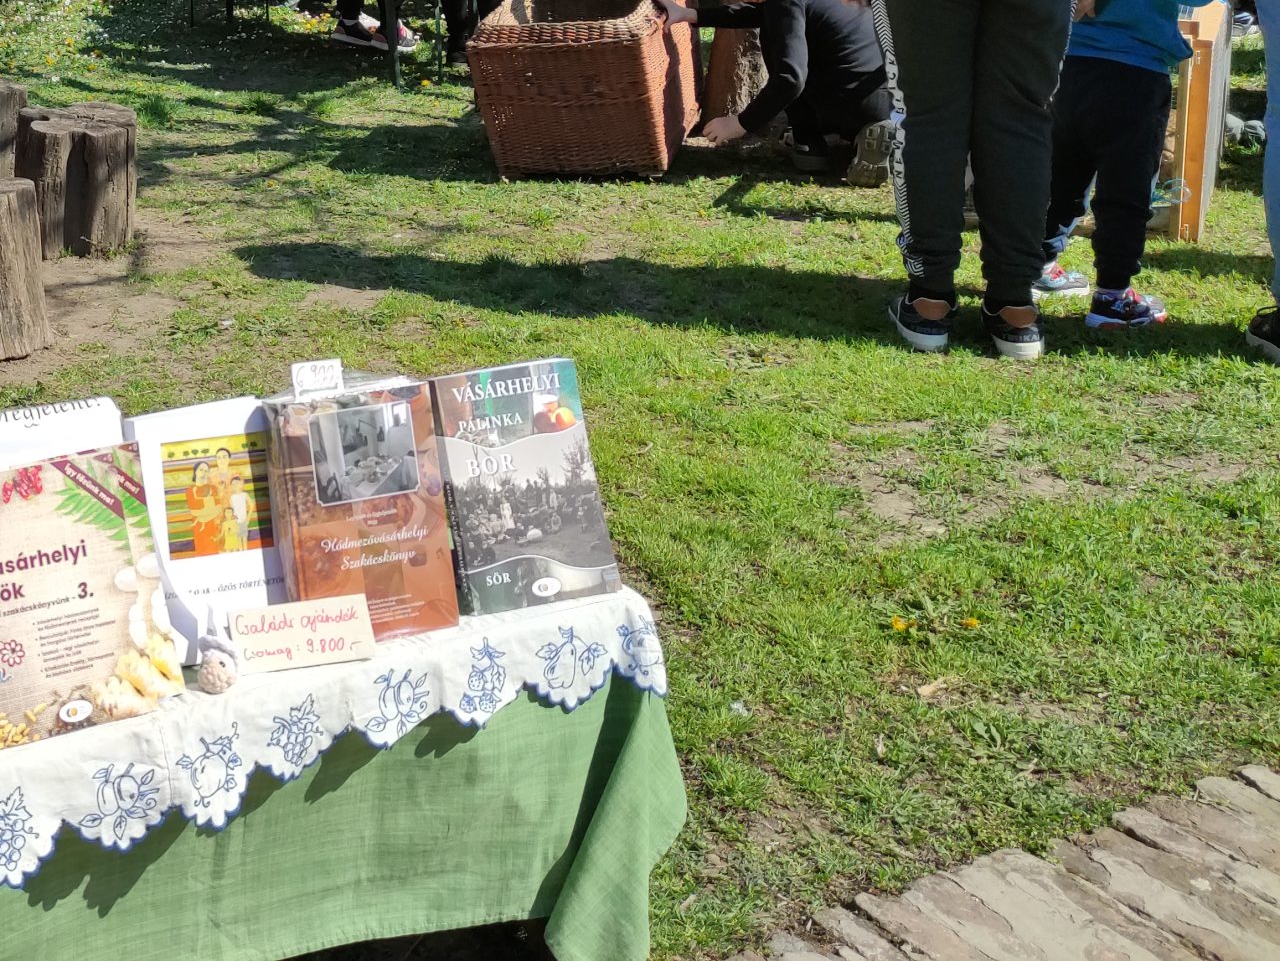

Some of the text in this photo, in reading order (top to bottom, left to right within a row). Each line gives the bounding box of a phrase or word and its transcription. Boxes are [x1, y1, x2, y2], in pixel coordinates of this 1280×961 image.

[452, 373, 561, 403] VÁSÁRHELYI
[459, 412, 523, 432] PÁLINKA
[466, 453, 516, 478] BOR
[320, 525, 429, 553] Hódmezővásárhelyi
[340, 549, 417, 570] Szakácskönyv
[77, 581, 95, 599] 3.
[485, 572, 512, 587] SÖR
[236, 612, 296, 636] Családi
[300, 606, 359, 632] ajándék
